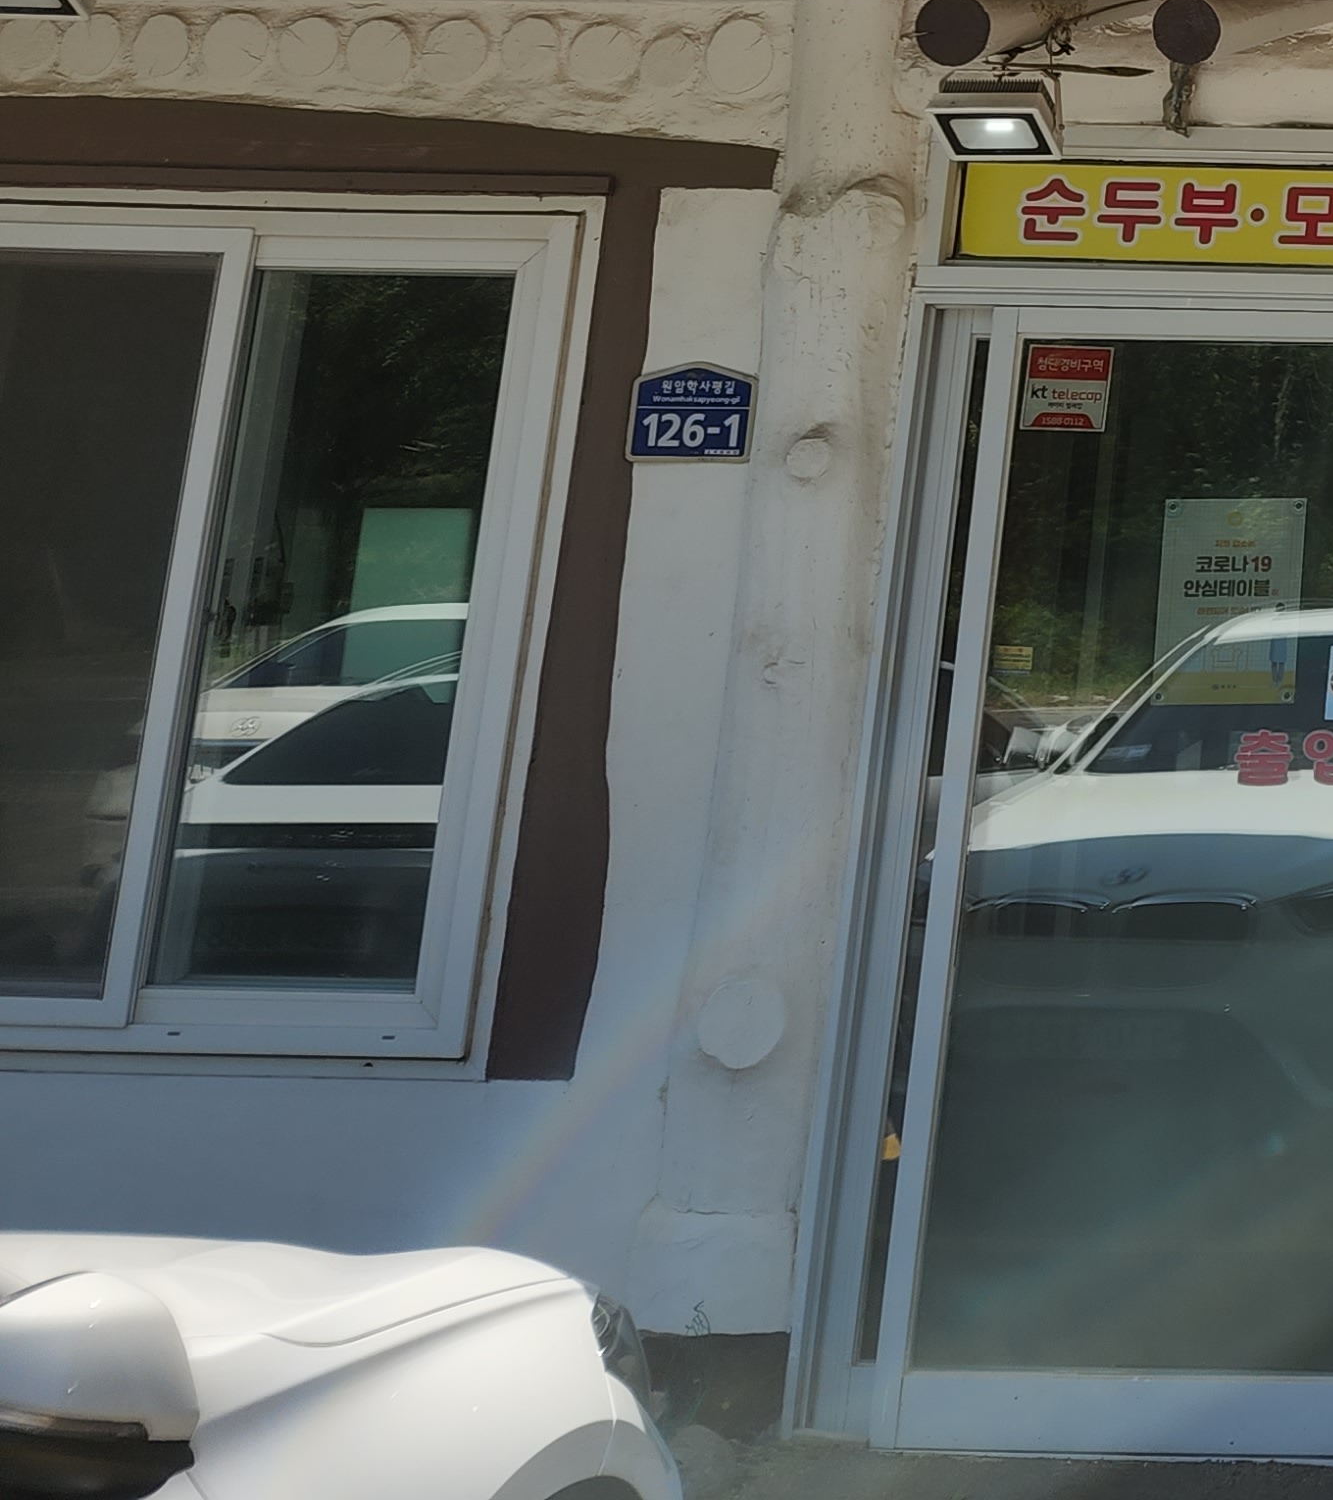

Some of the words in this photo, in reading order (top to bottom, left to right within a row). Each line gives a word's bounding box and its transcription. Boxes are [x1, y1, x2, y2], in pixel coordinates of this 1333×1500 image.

[1037, 356, 1104, 372] 첨단경비구역
[661, 380, 736, 395] 원암학사평길
[1030, 383, 1048, 399] kt
[642, 413, 741, 448] 126-1
